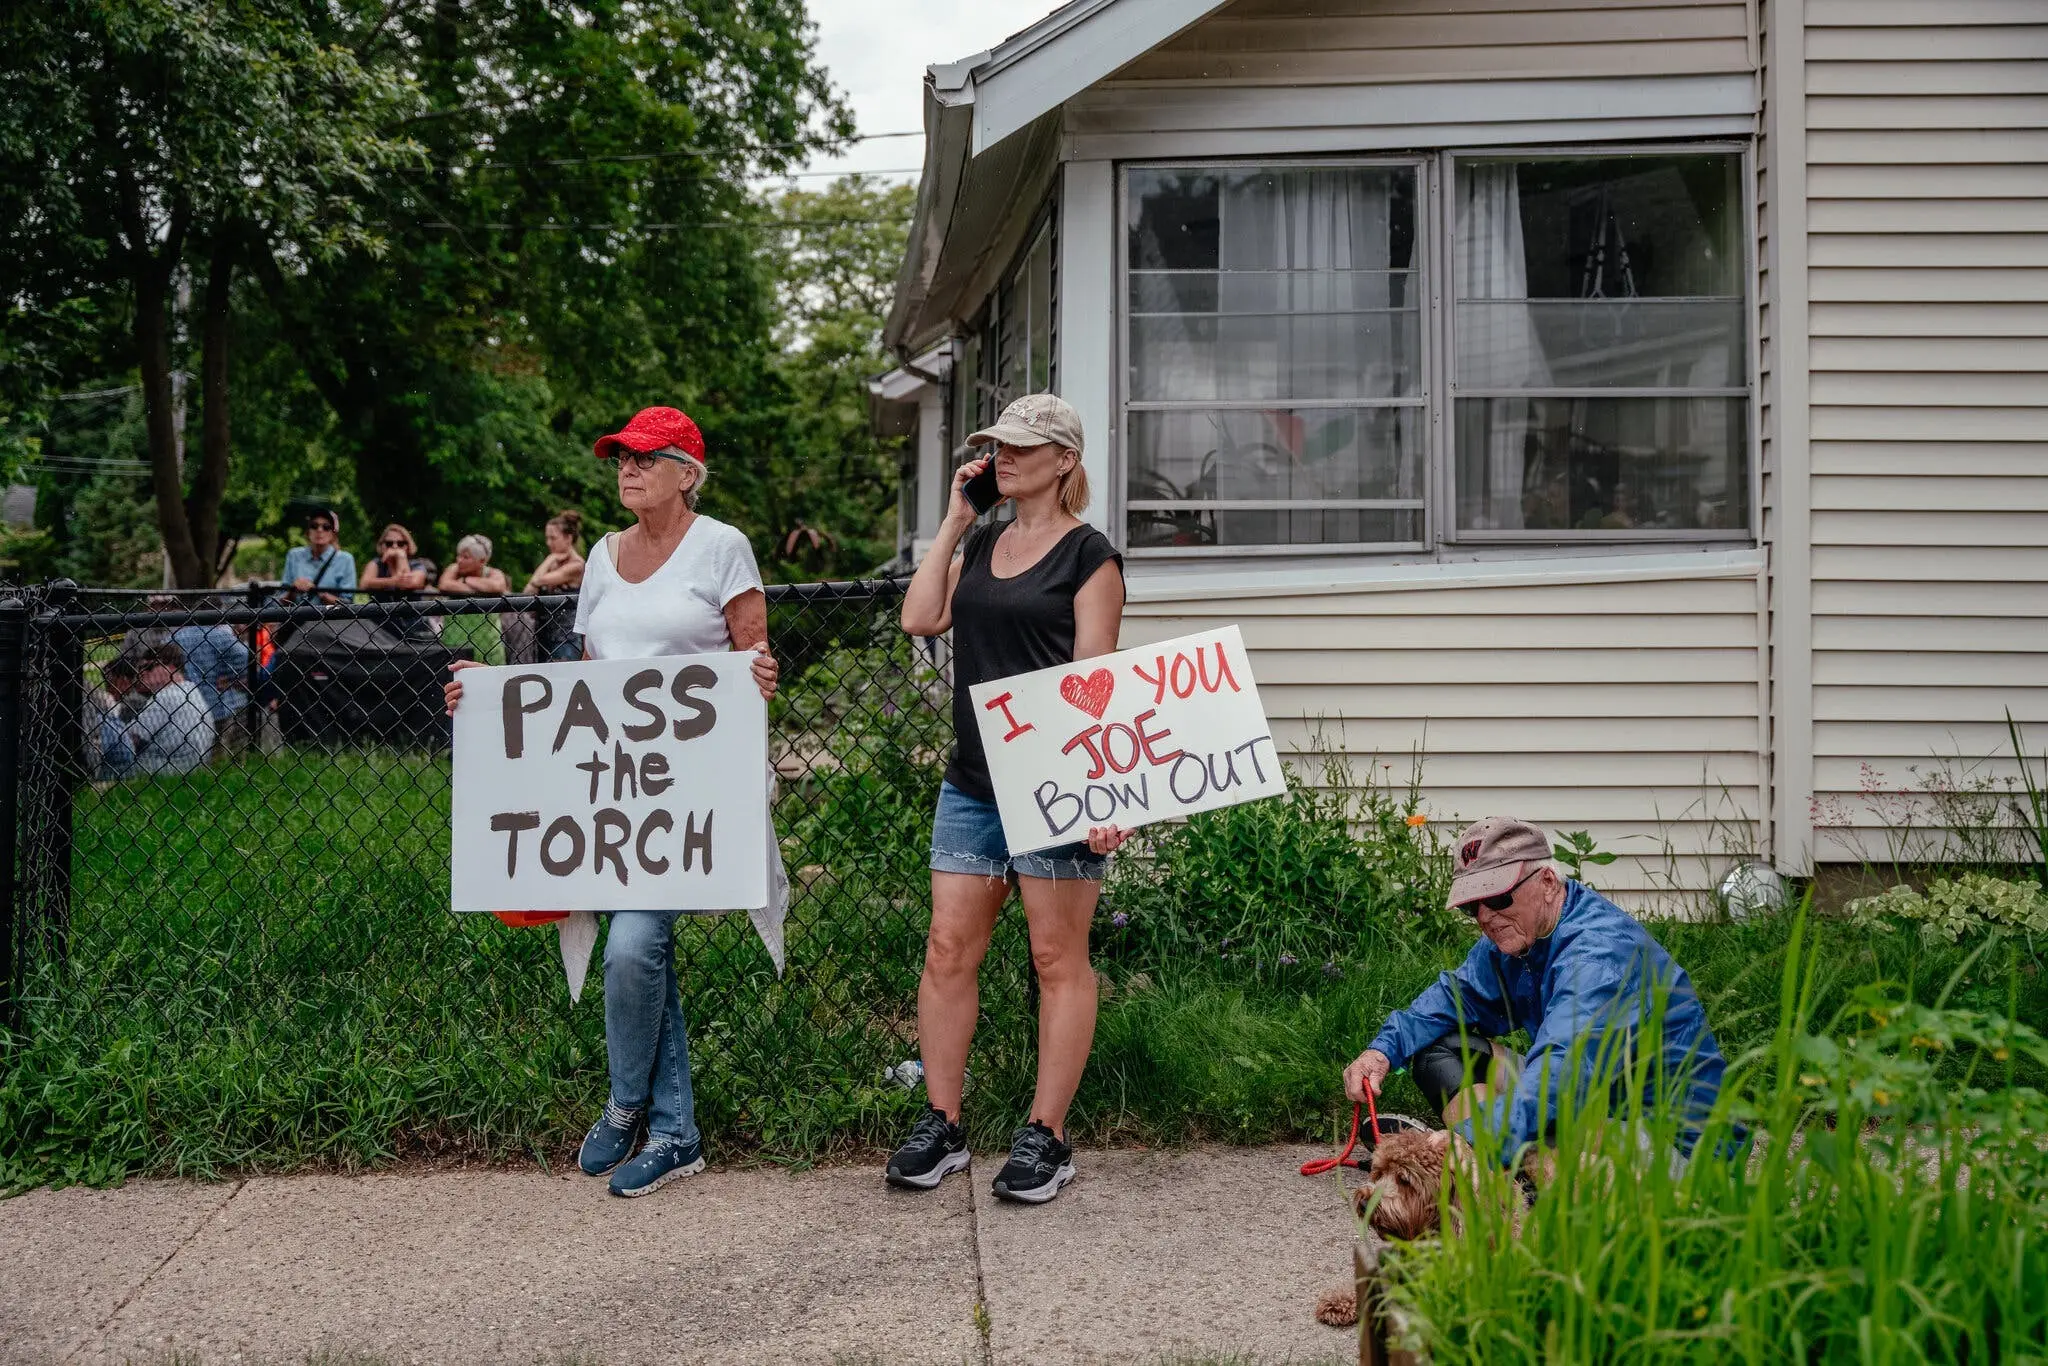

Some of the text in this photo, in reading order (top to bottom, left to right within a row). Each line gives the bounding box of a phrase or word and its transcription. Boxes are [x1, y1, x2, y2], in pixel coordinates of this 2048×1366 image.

[502, 665, 718, 760] PASS
[985, 642, 1241, 742] I YOU
[576, 740, 675, 804] the
[1034, 735, 1271, 838] BOW OUT
[1062, 709, 1183, 780] JOE
[490, 808, 713, 886] TORCH
